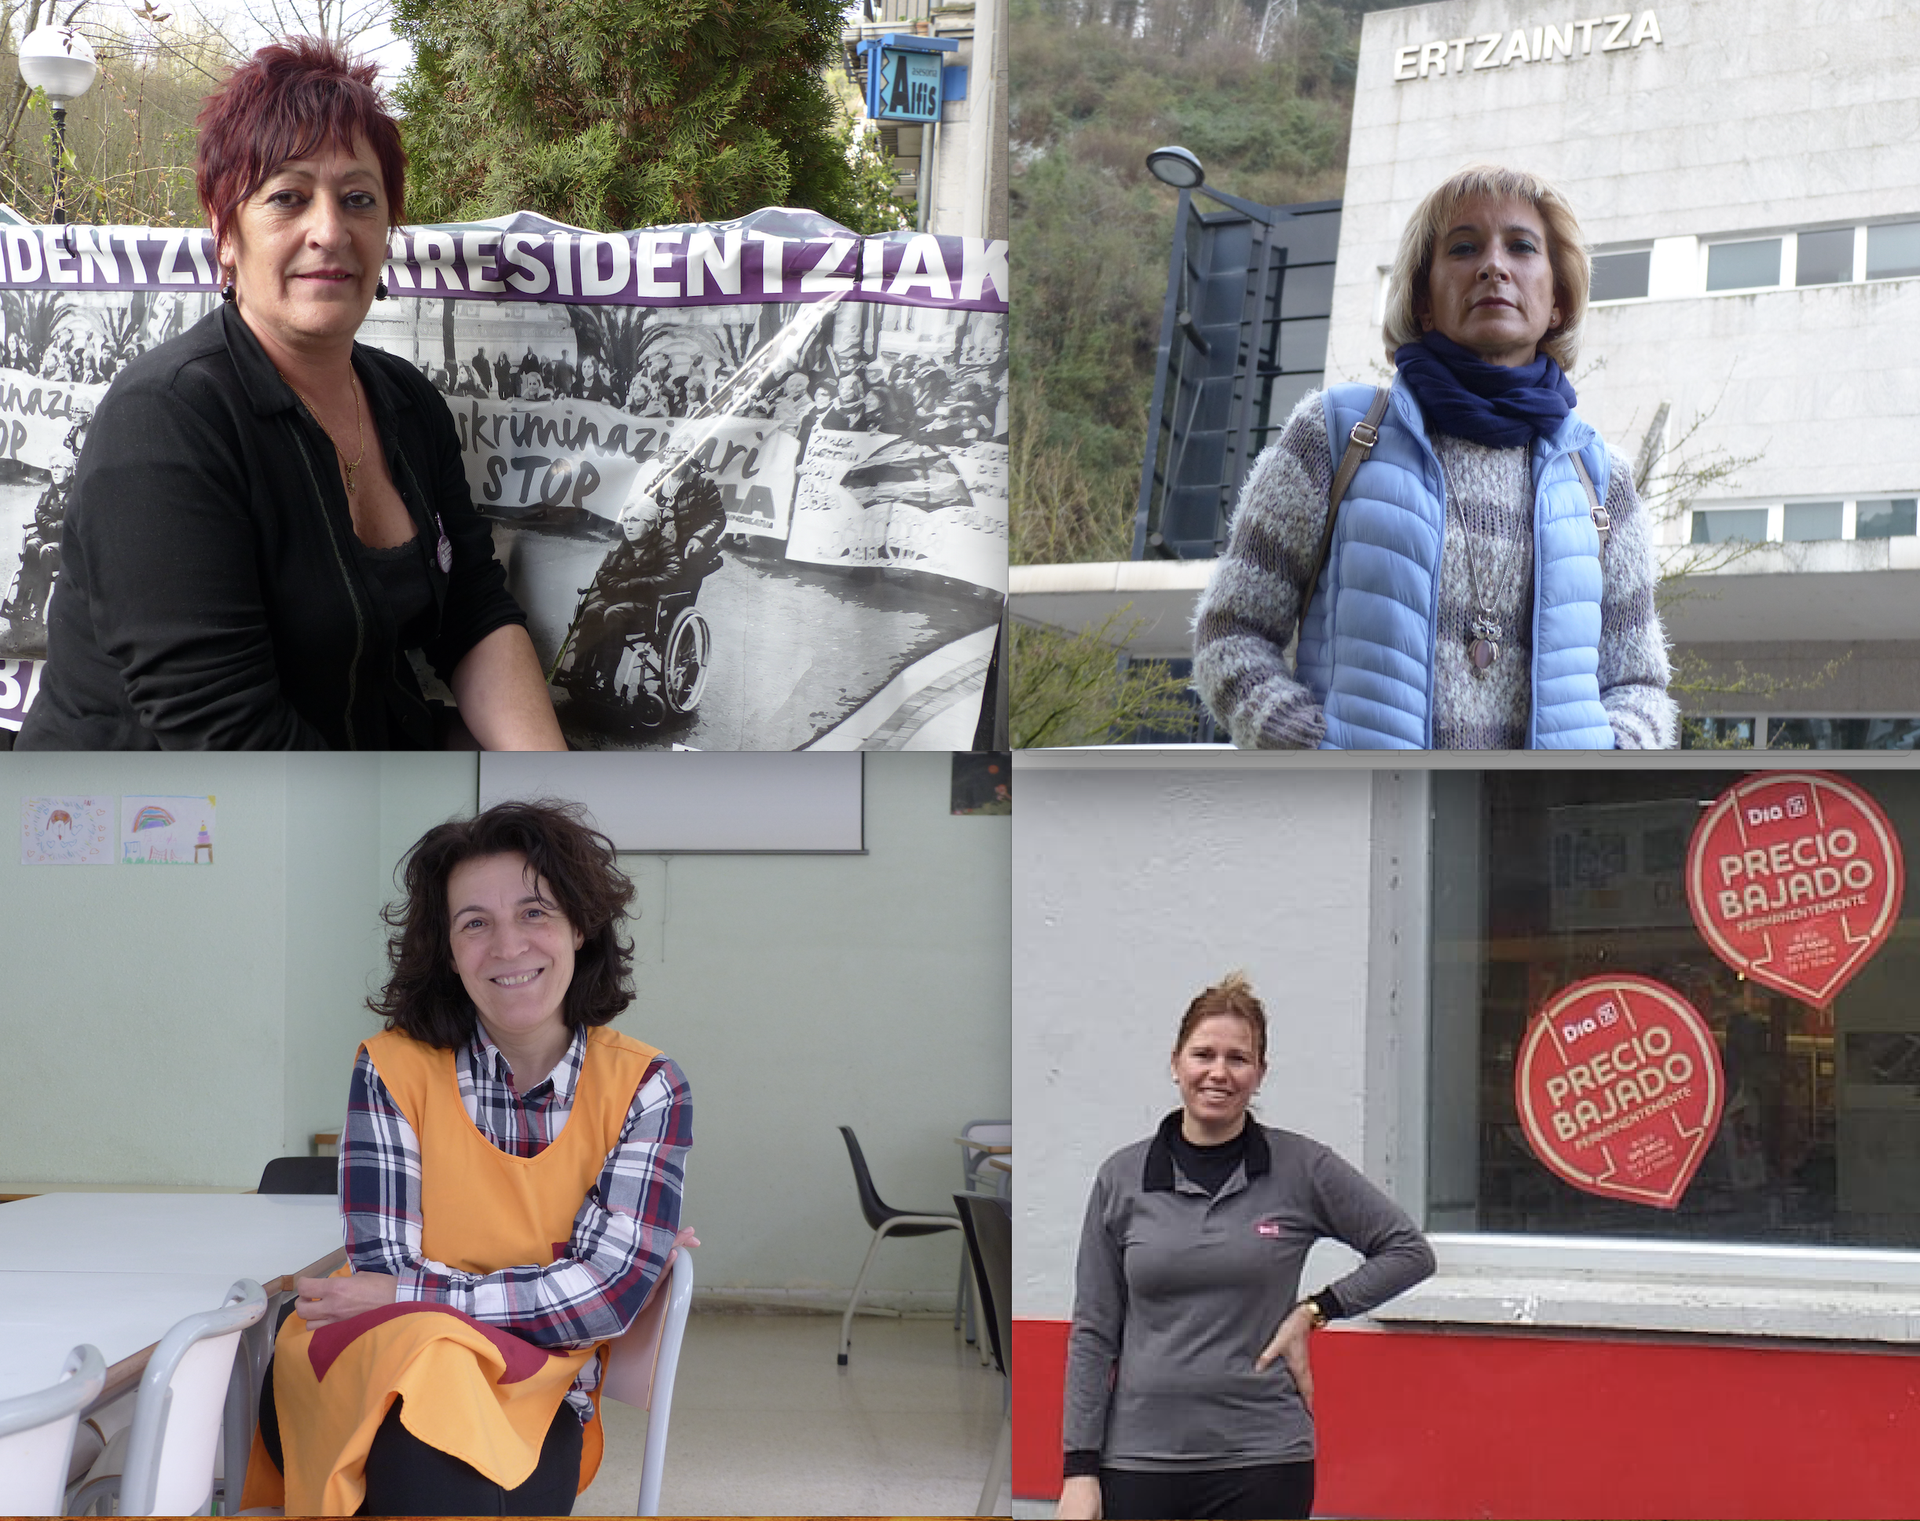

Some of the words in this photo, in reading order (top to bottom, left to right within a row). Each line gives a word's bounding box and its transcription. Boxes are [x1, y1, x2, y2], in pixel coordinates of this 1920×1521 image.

[1394, 9, 1663, 82] ERTZAINTZA
[0, 225, 221, 284] DENTZI
[483, 455, 601, 508] STOP
[716, 483, 776, 520] LA
[1719, 829, 1858, 886] PRECIO
[1718, 859, 1874, 919] BAJADO
[1546, 1027, 1672, 1107] PRECIO
[1552, 1053, 1694, 1142] BAJADO
